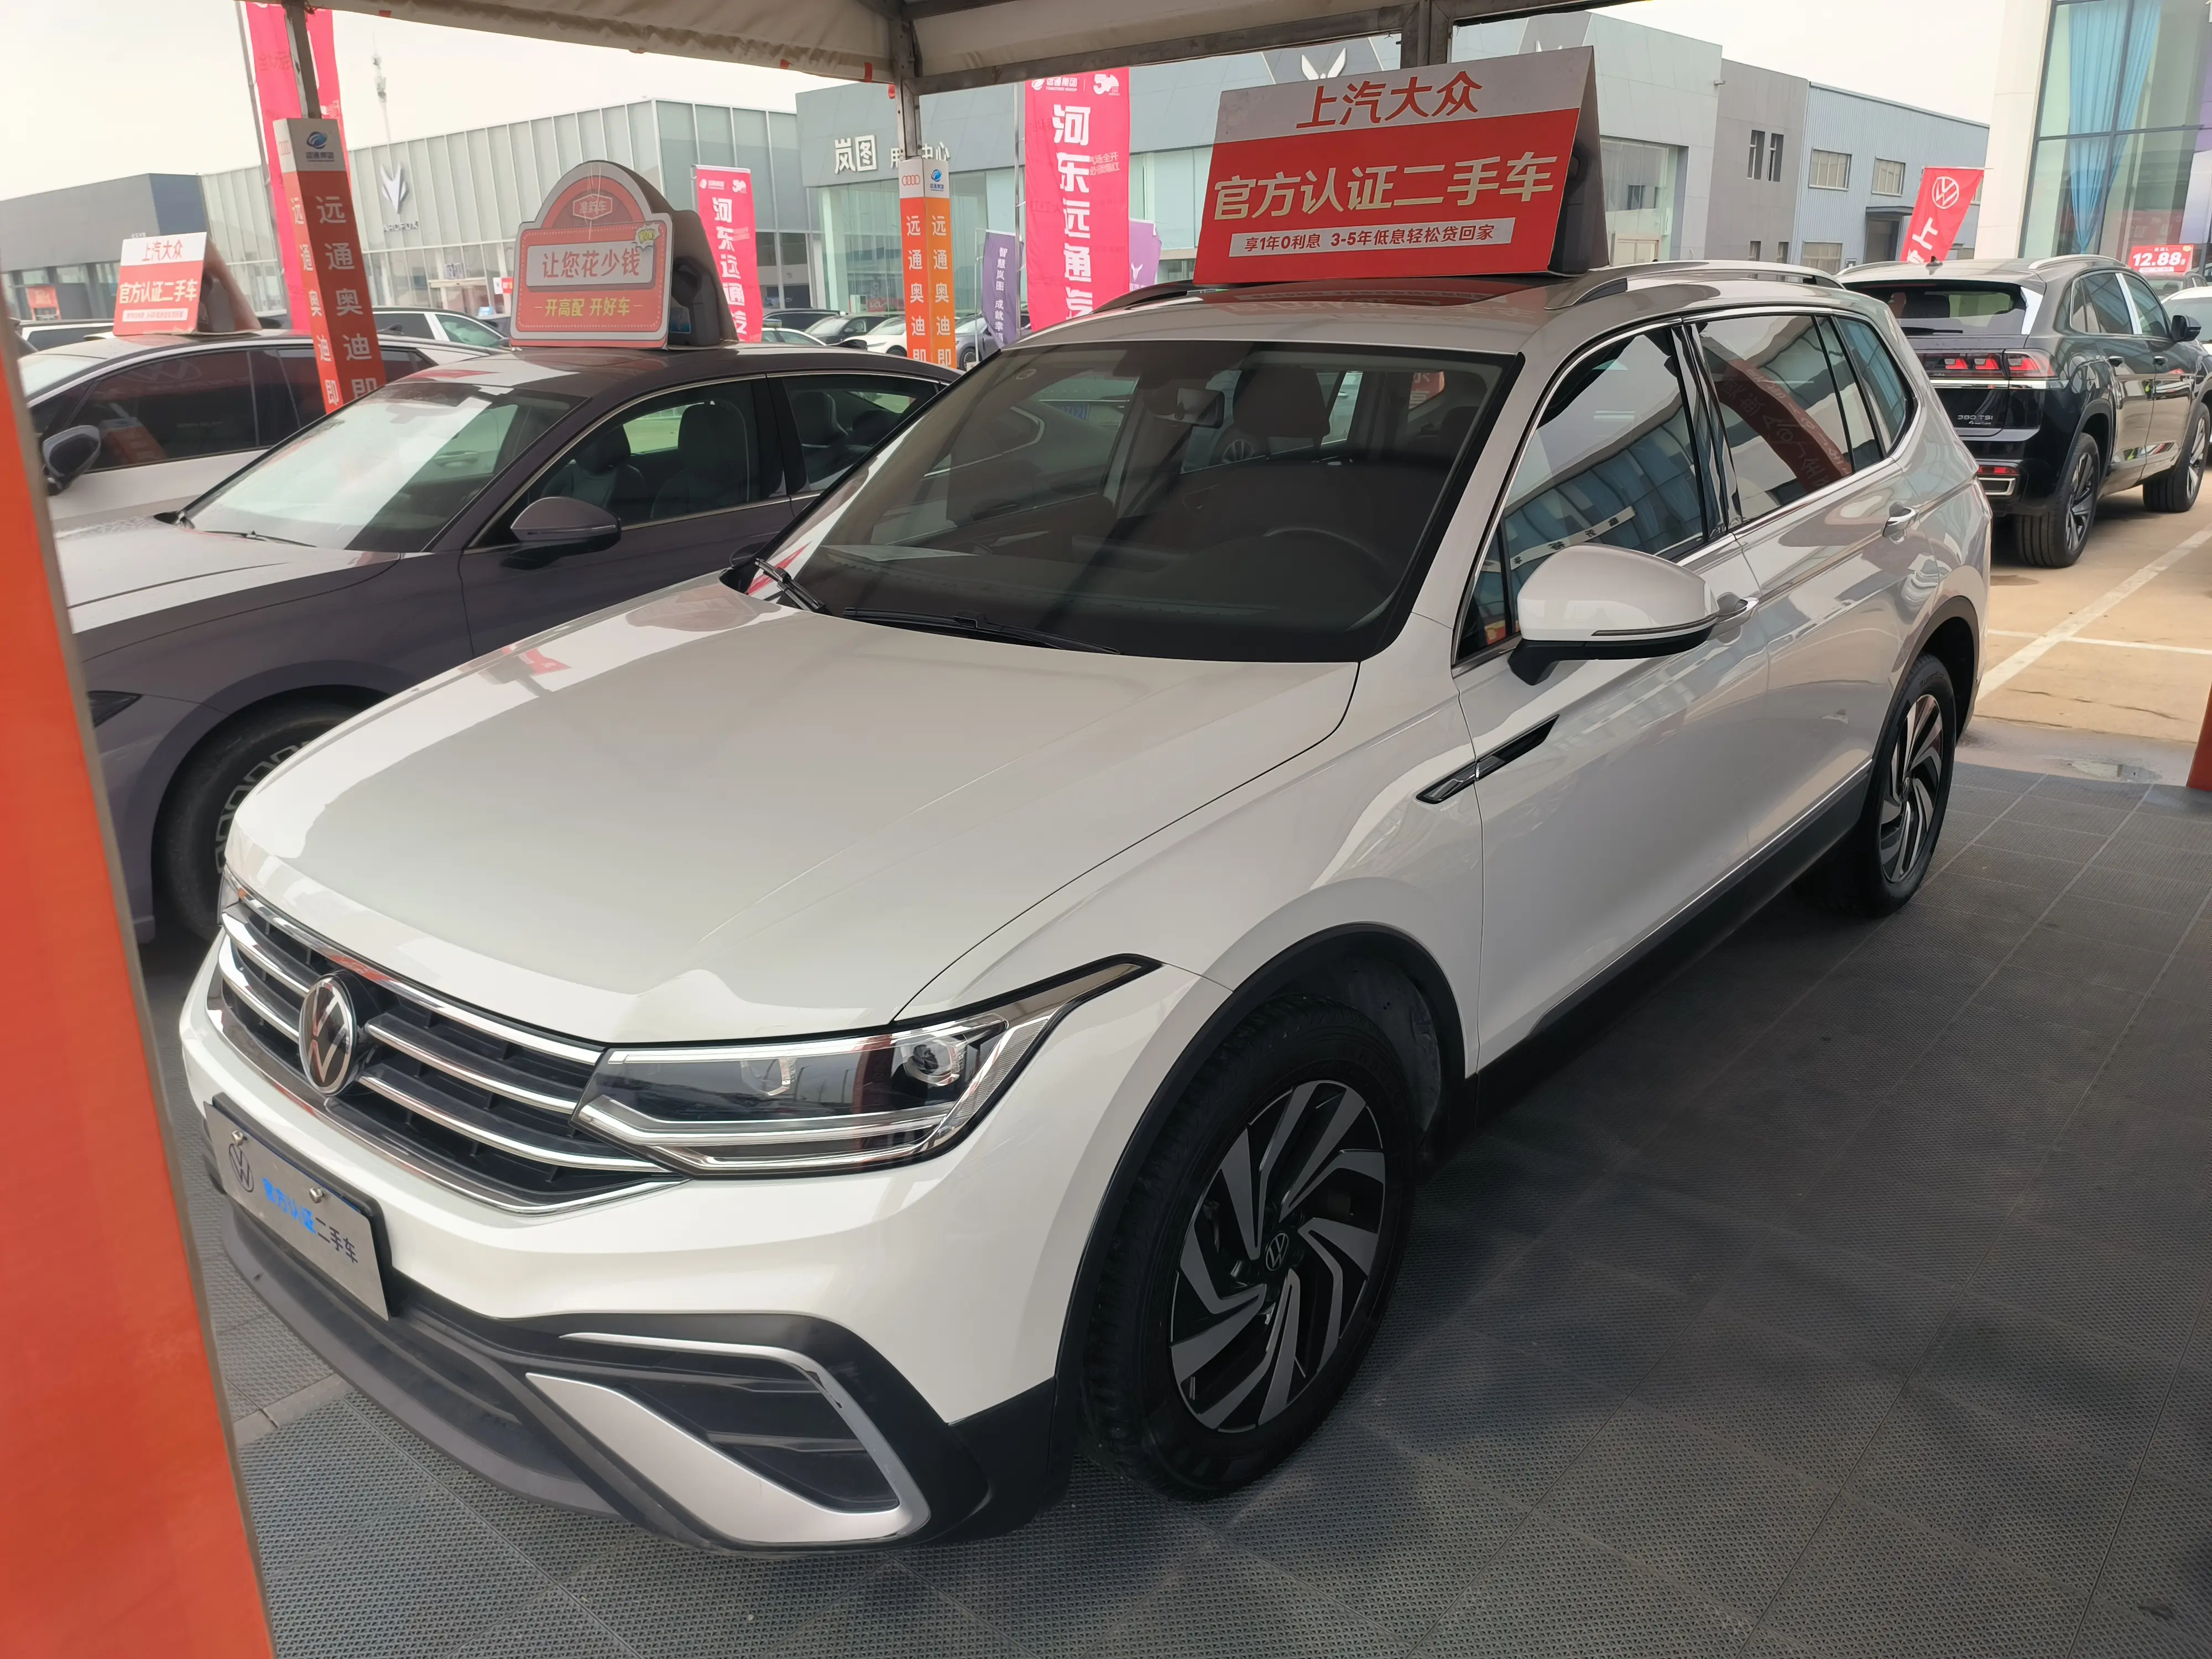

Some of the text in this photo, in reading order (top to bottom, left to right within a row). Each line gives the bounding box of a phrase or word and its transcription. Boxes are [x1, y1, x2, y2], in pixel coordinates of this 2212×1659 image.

[1296, 71, 1483, 129] 上汽大众
[834, 135, 877, 175] 岚图
[1214, 152, 1557, 220] 官方认证二手车
[142, 239, 184, 262] 上汽大众
[638, 228, 656, 243] WOW!
[1245, 224, 1495, 252] 享1年0利息 3-5年低息轻松贷回家
[542, 248, 640, 278] 让您花少钱
[995, 247, 1008, 291] 智慧岚图
[119, 278, 199, 304] 官方认证二手车
[290, 196, 341, 406] 远通奥迪即
[545, 296, 630, 317] 开高配 开好车
